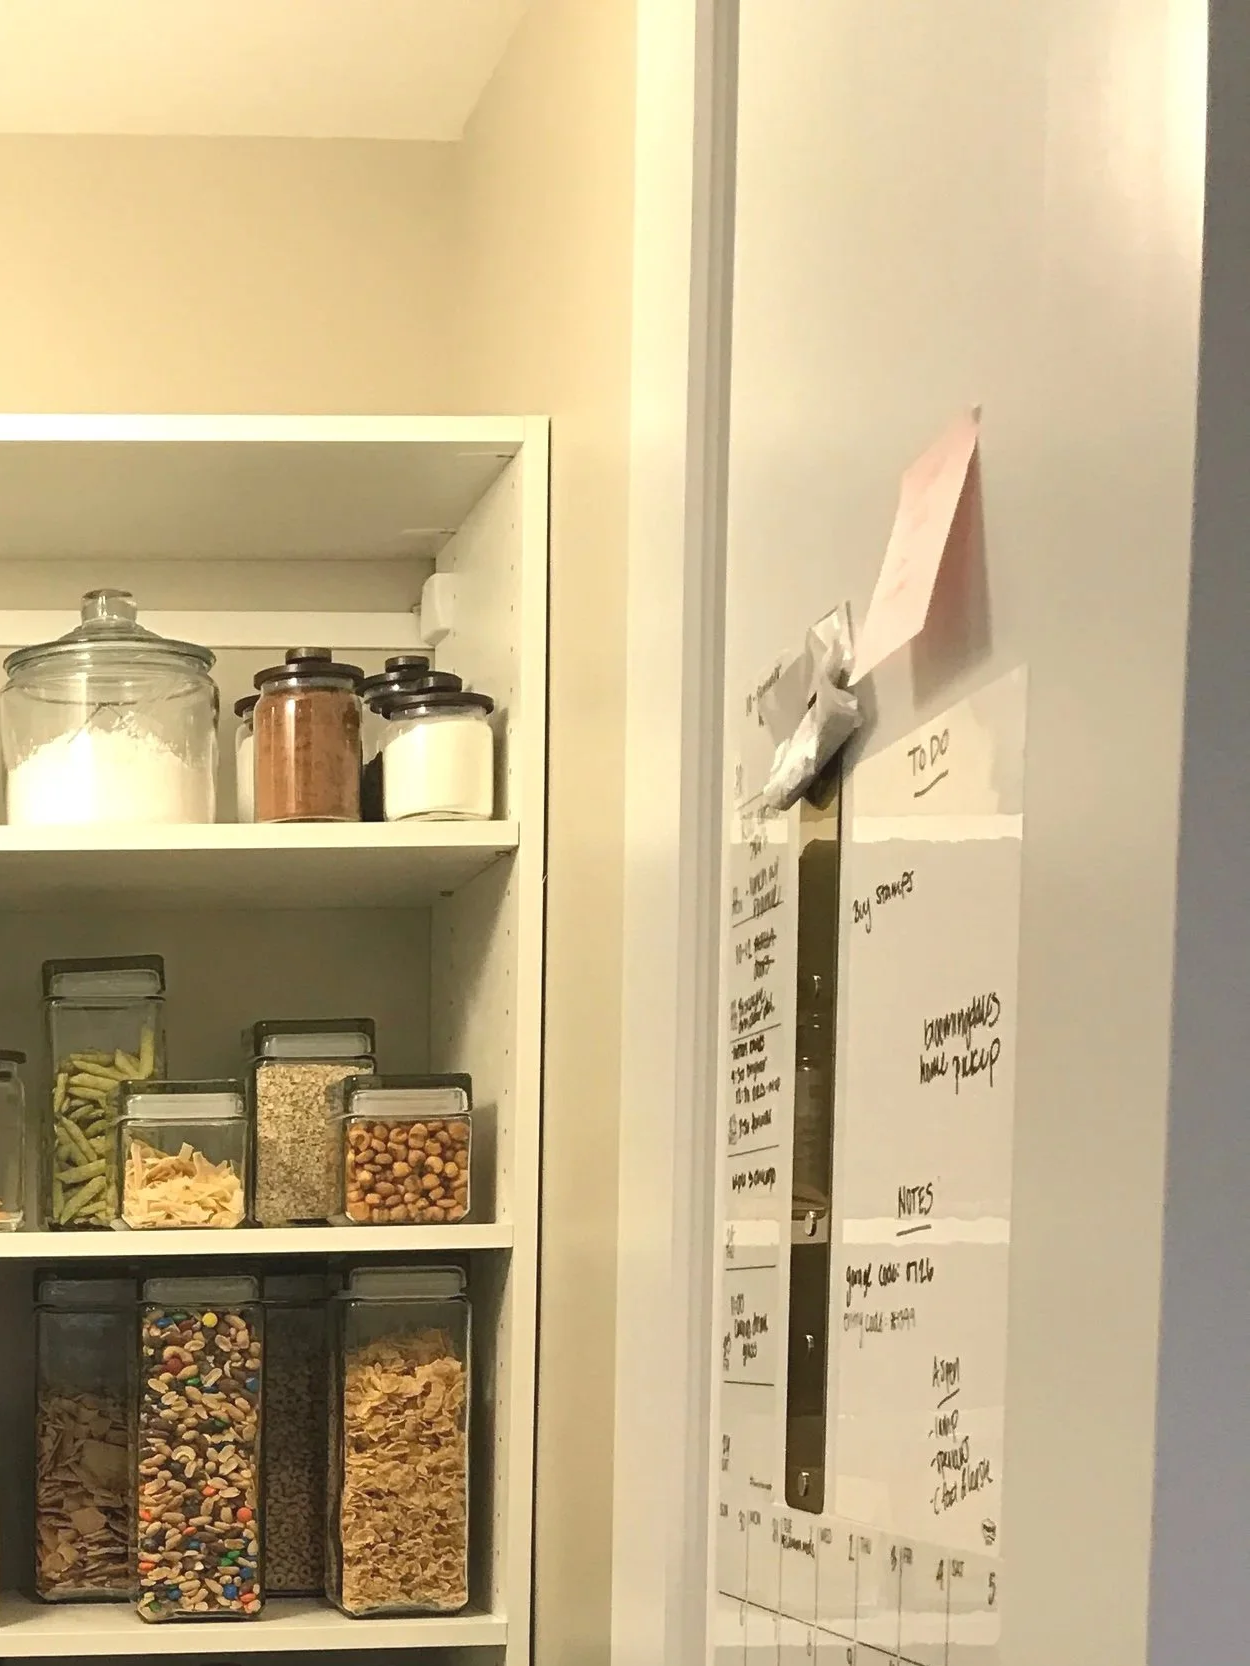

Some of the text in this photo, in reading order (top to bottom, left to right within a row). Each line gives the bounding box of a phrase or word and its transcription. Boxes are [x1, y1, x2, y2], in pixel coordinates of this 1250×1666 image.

[930, 728, 950, 768] DO
[897, 1181, 935, 1219] NOTES
[988, 1571, 996, 1606] 5
